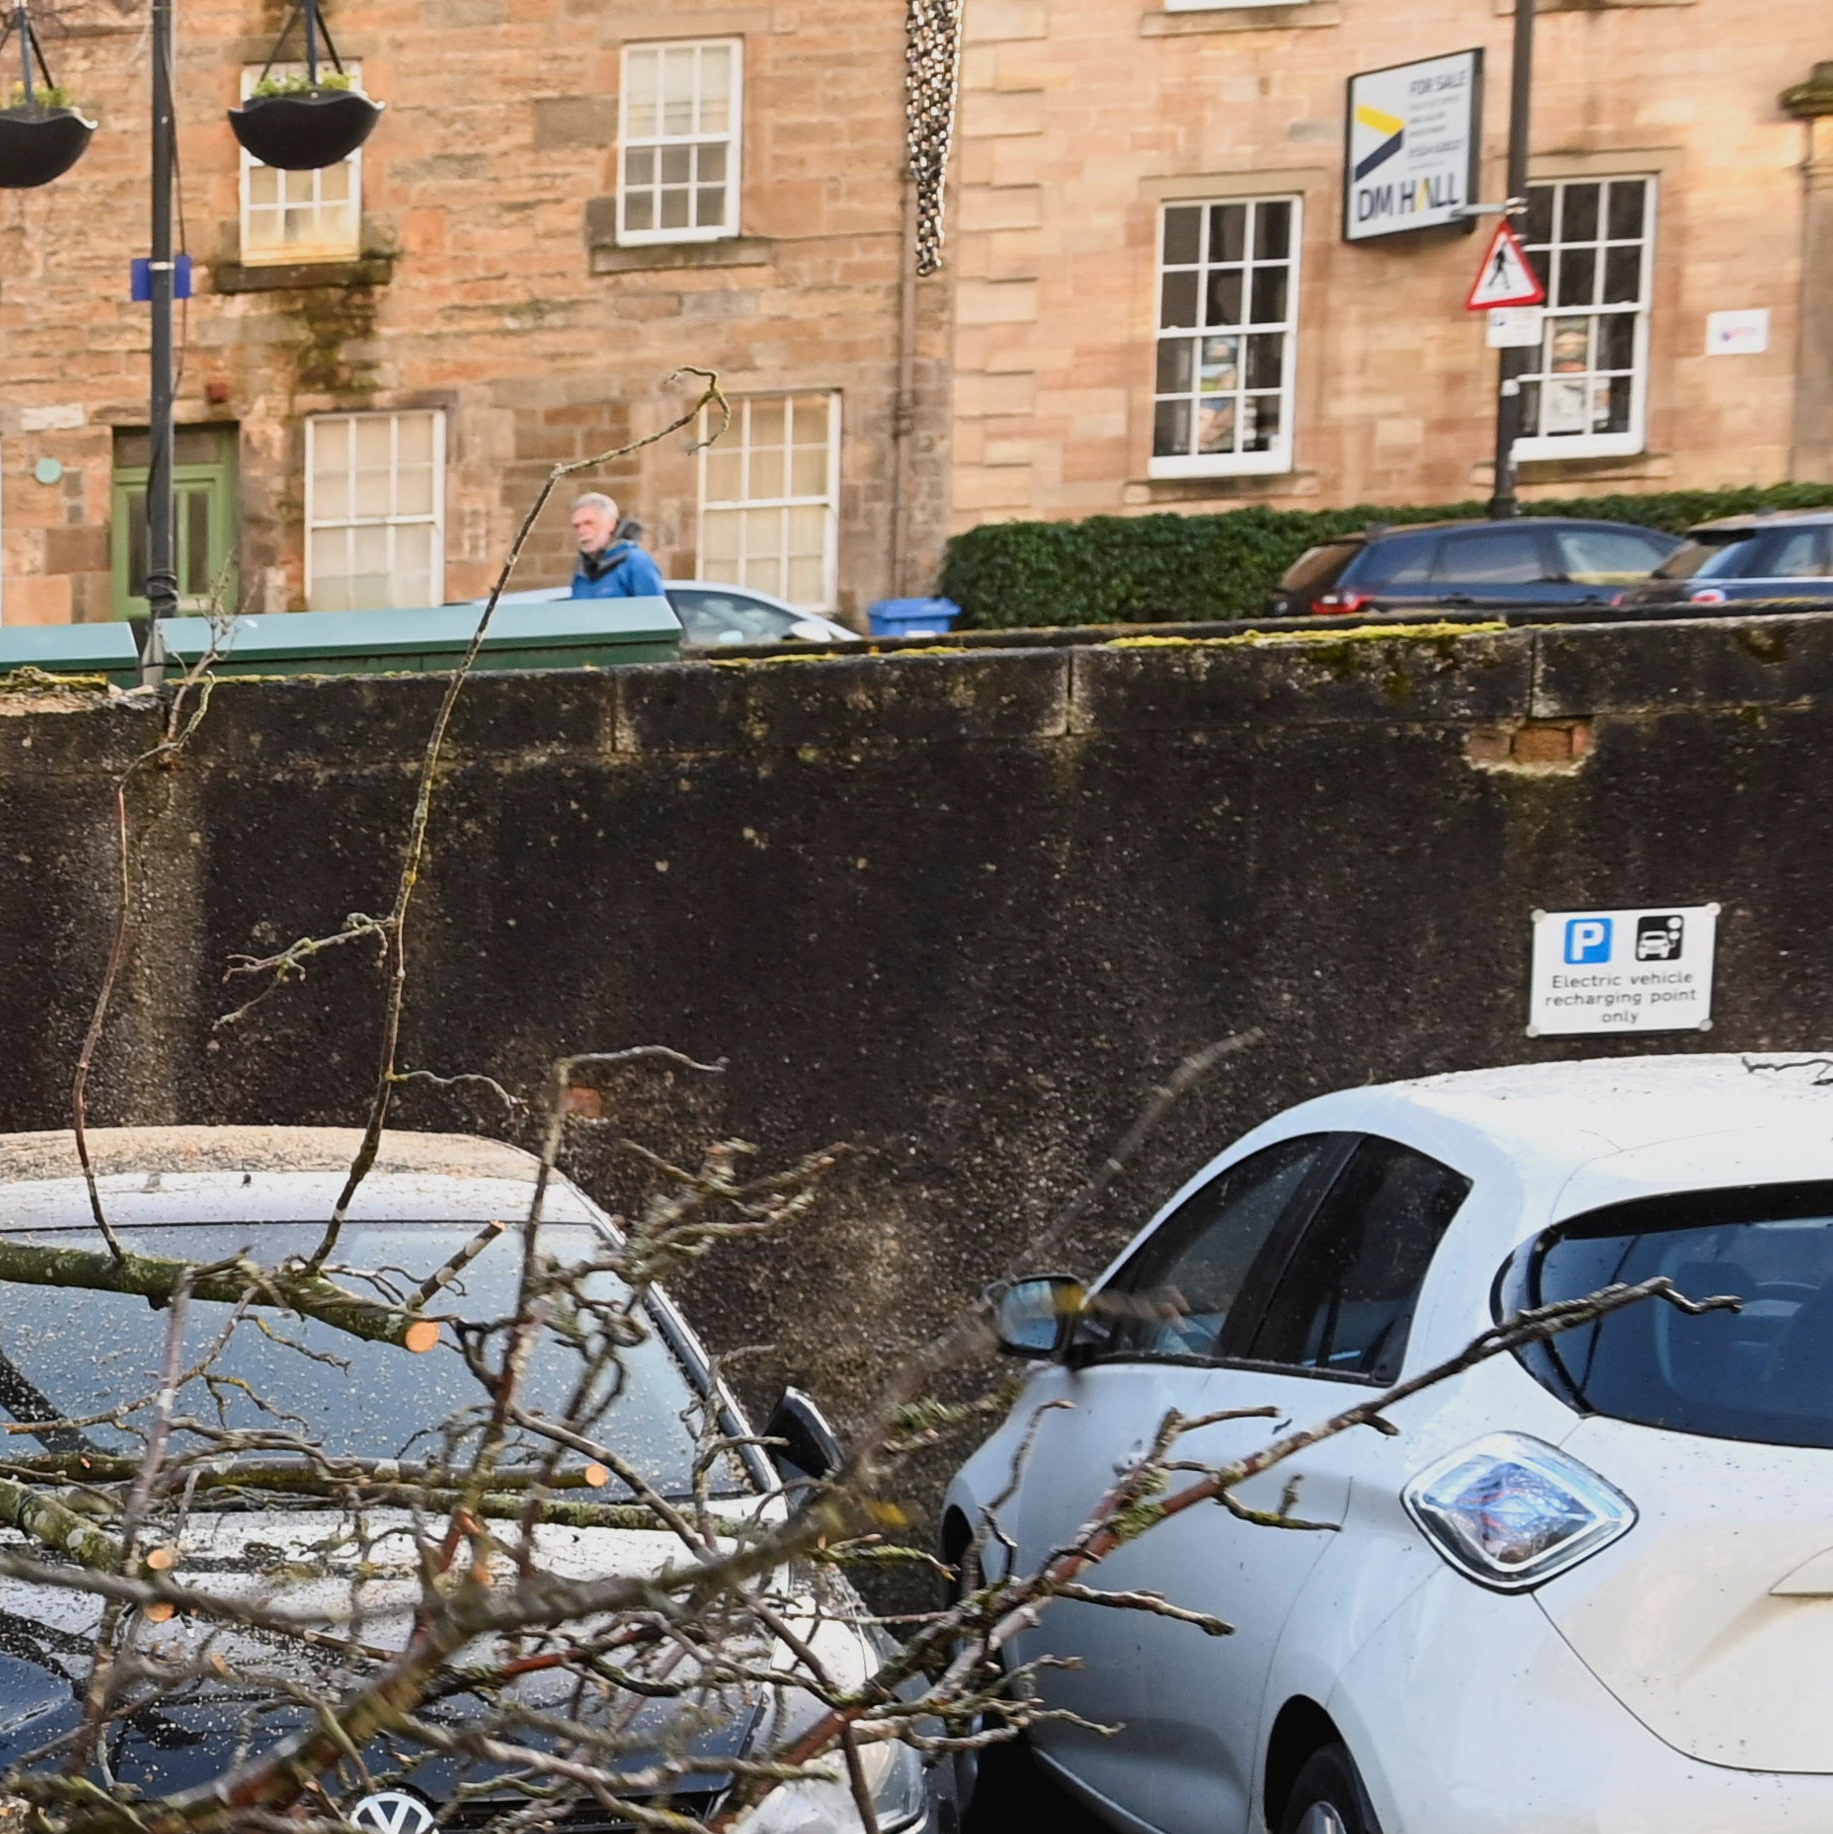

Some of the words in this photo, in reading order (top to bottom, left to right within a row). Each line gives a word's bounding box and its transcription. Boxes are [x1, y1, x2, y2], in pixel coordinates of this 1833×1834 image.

[1358, 184, 1393, 222] DM
[1399, 172, 1459, 215] HALL
[1571, 922, 1606, 961] P
[1552, 973, 1622, 989] Electric
[1630, 971, 1693, 986] vehicle
[1545, 992, 1642, 1007] recharging
[1650, 988, 1697, 1004] point
[1601, 1010, 1640, 1025] only
